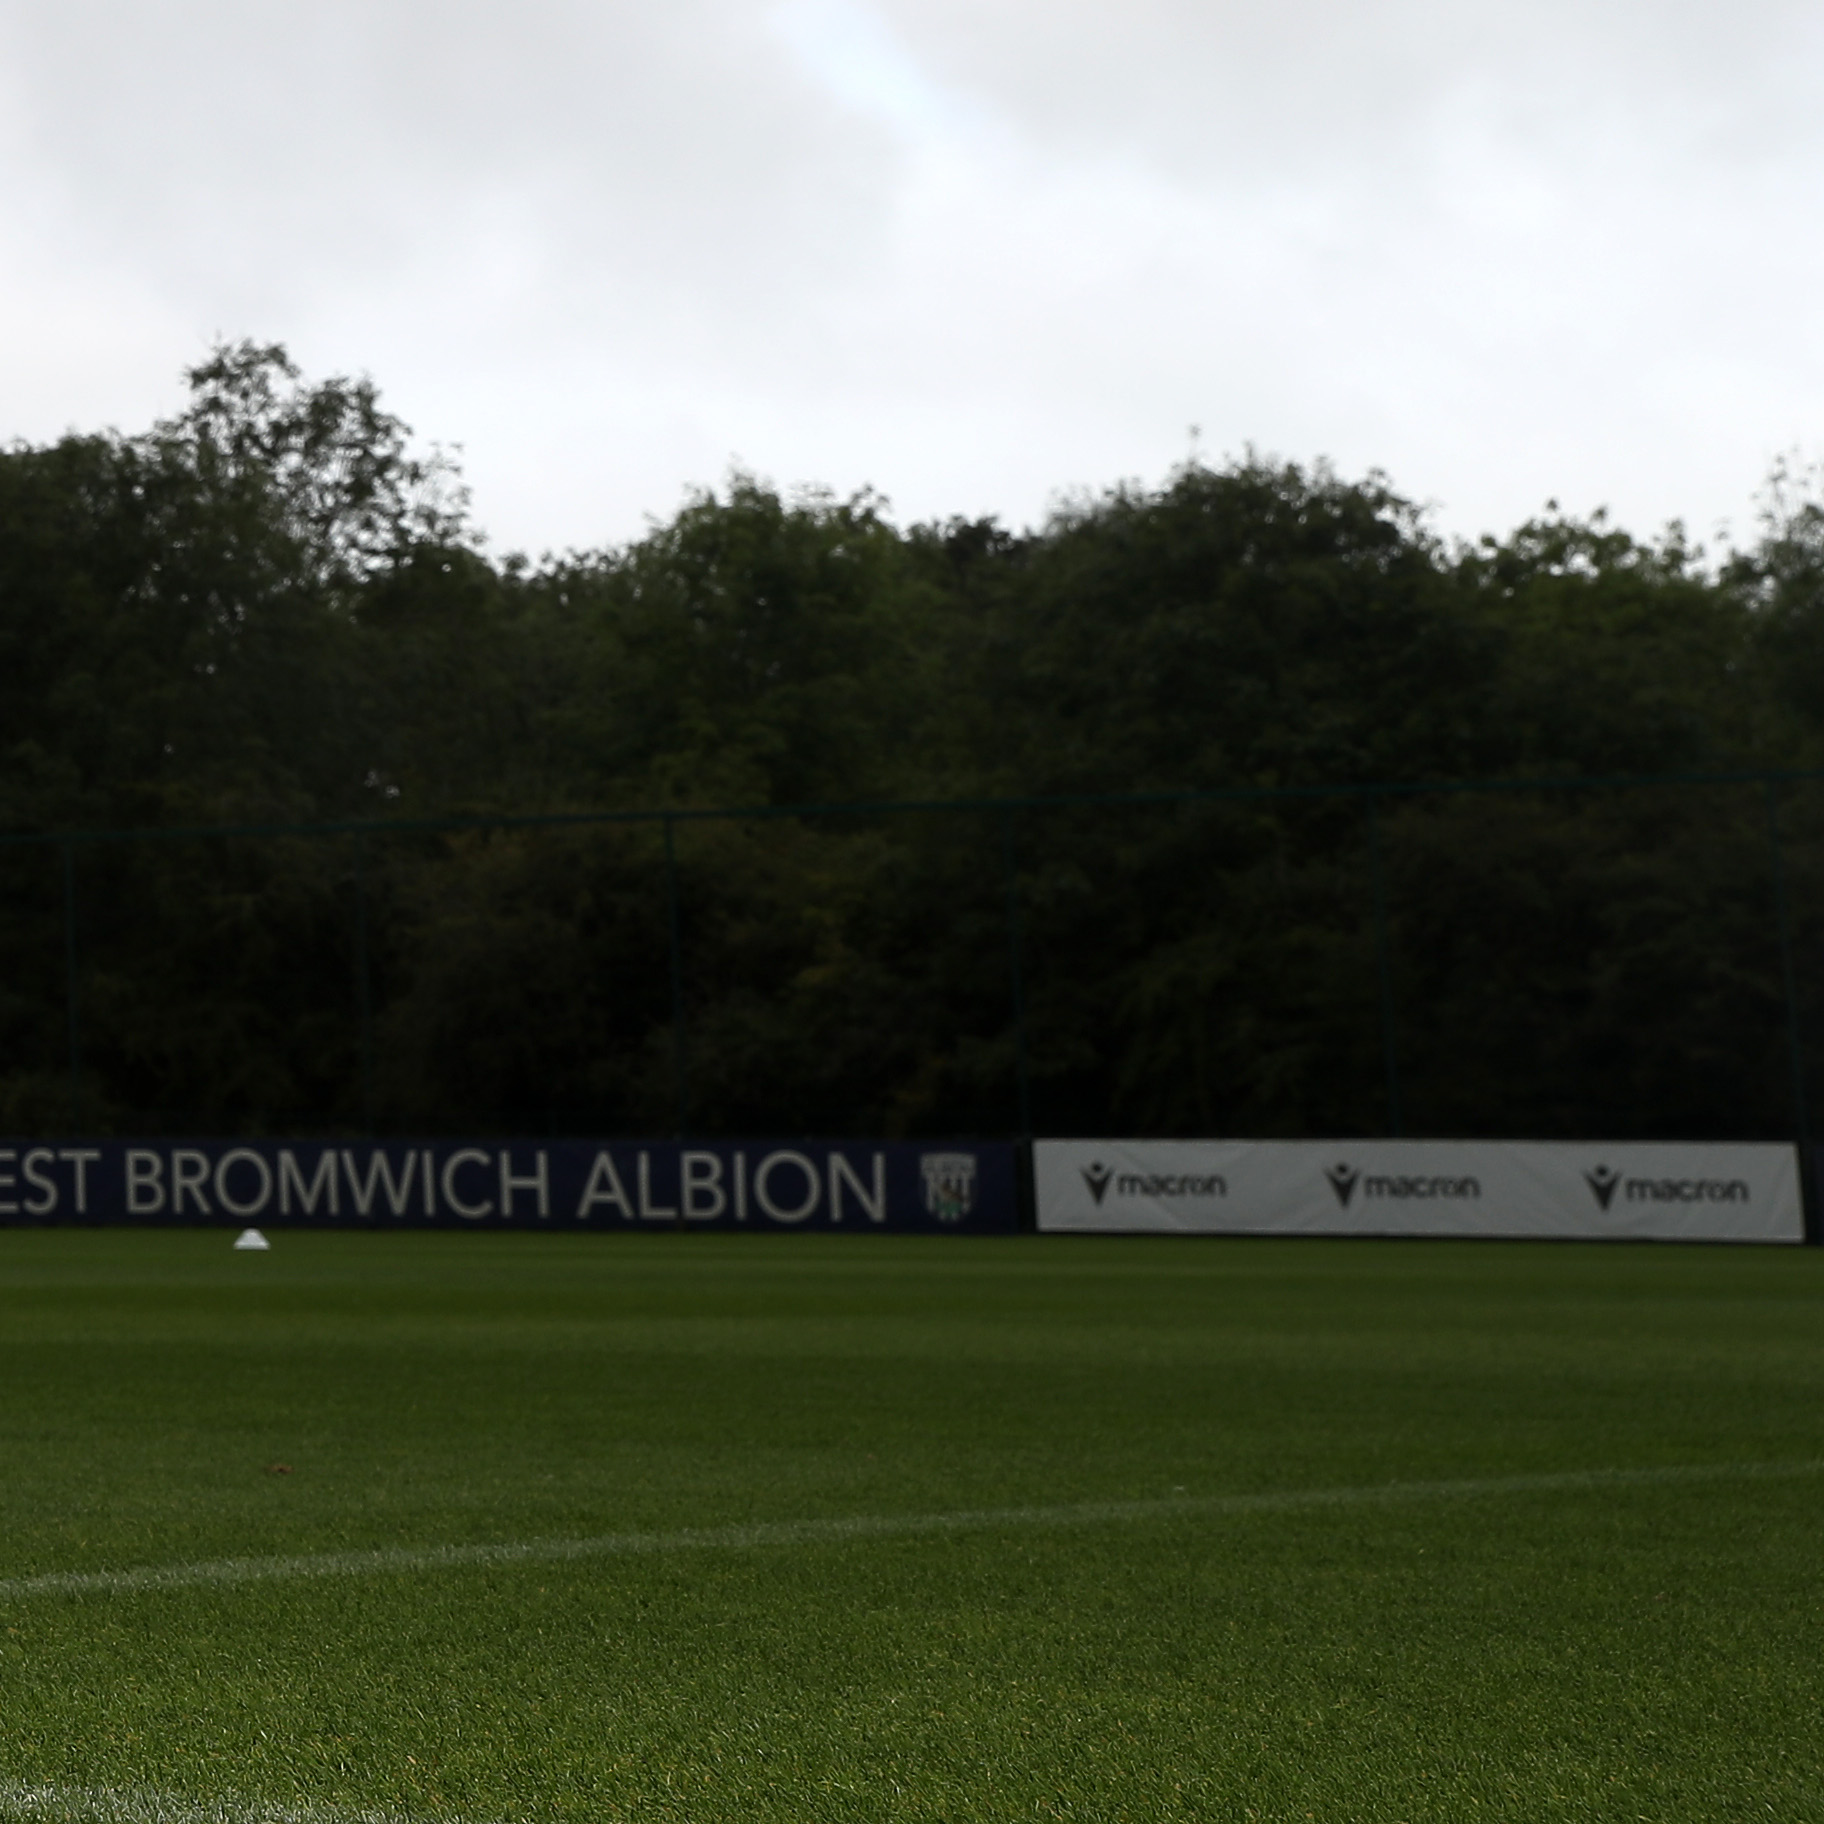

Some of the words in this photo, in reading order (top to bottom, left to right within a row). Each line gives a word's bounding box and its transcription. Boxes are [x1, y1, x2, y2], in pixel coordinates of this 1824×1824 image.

[124, 1147, 548, 1219] BROMWICH
[575, 1148, 886, 1223] ALBION
[1117, 1174, 1227, 1197] macron
[1364, 1175, 1481, 1199] macron
[1625, 1177, 1750, 1204] macron
